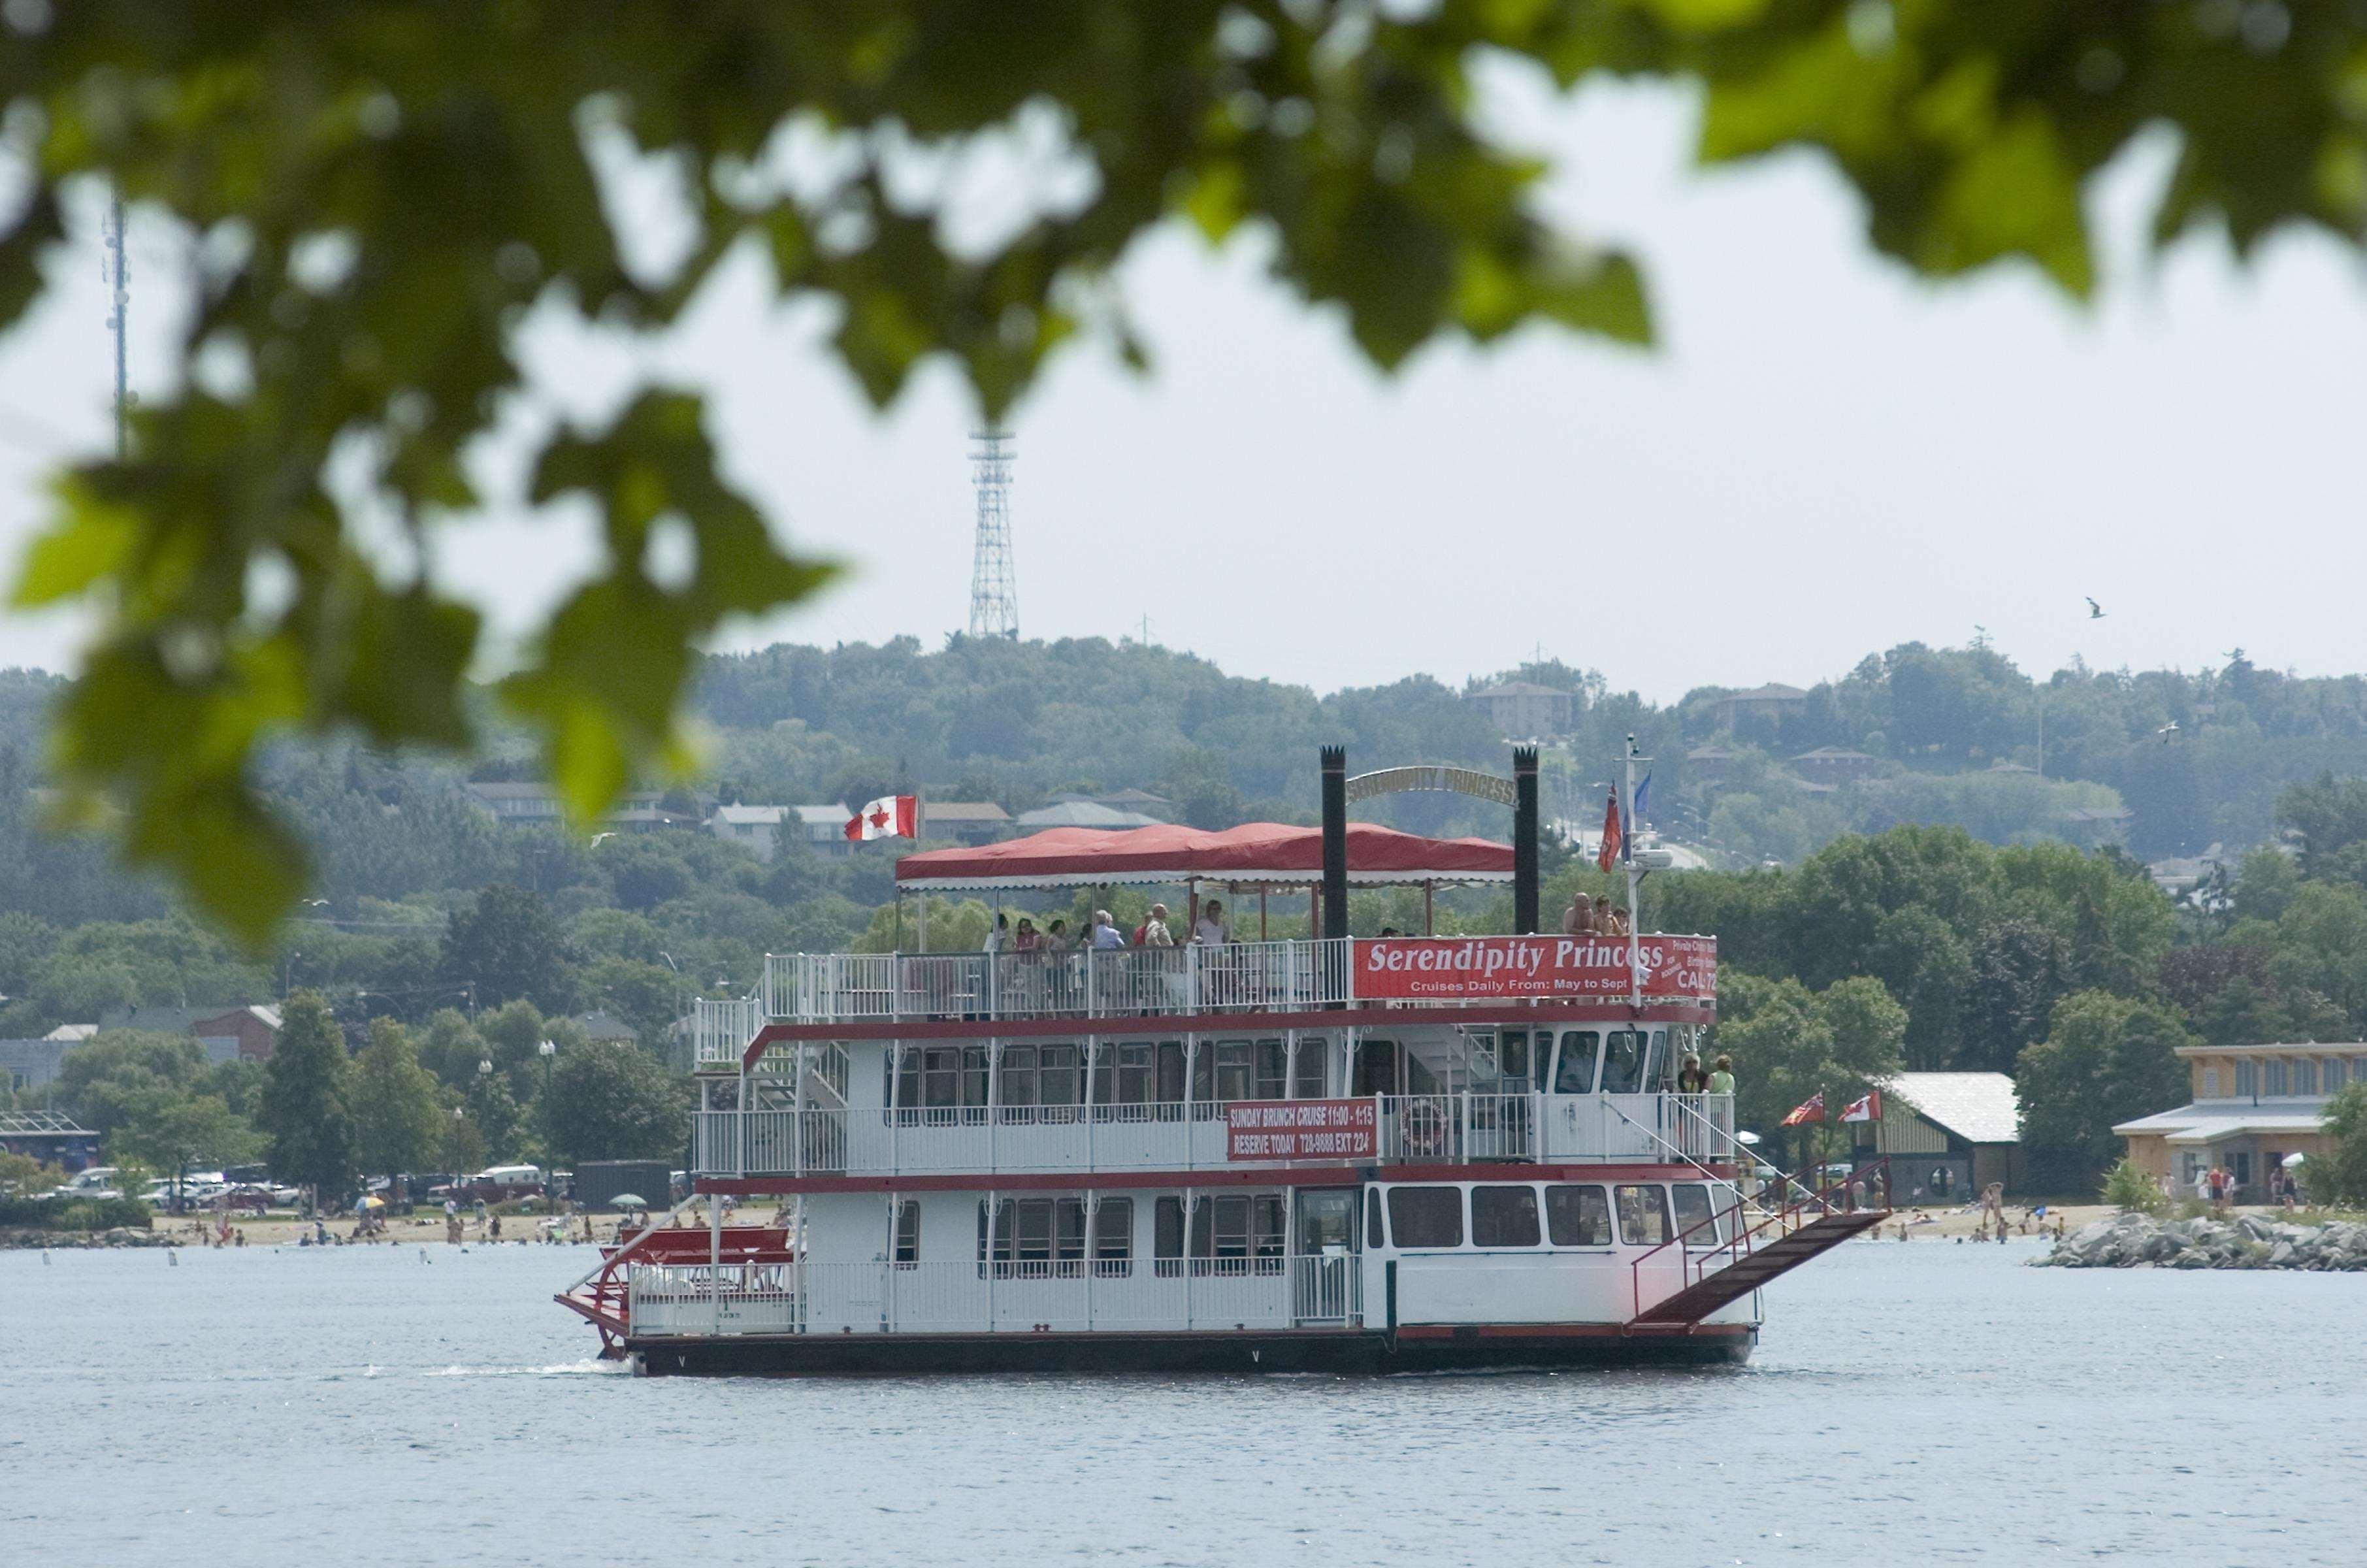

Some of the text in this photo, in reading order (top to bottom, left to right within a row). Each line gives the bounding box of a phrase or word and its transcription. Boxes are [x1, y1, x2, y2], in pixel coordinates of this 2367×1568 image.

[1368, 941, 1544, 978] Serendipity
[1411, 979, 1627, 992] Cruises Daily From: May to Sept
[1231, 1108, 1262, 1128] SUNDAY
[1263, 1107, 1295, 1127] BRUNCH
[1298, 1107, 1326, 1126] CRUISE
[1328, 1106, 1348, 1126] 11:00
[1356, 1105, 1373, 1125] 1:15
[1234, 1132, 1369, 1154] RESERVE TODAY 728-9888 EXT 224
